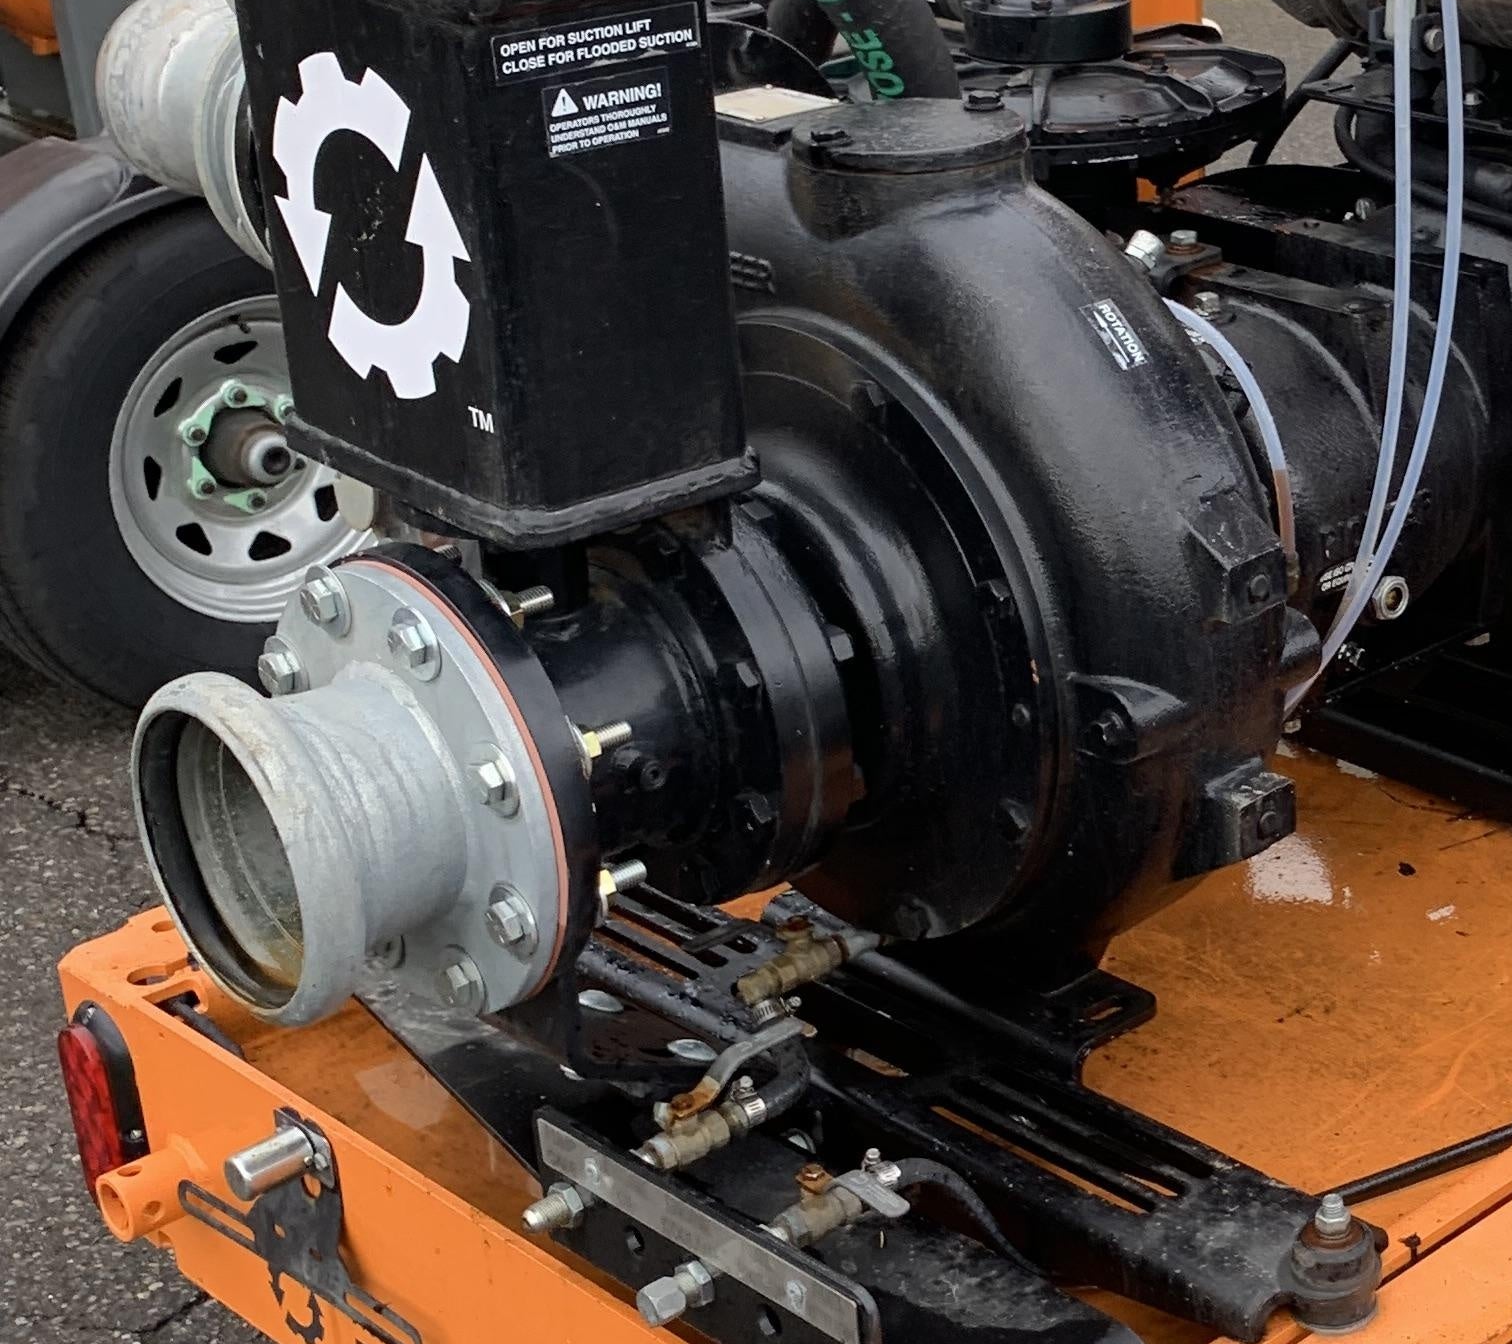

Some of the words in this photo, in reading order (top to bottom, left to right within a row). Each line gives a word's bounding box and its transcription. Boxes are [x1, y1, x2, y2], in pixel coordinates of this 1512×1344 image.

[500, 41, 537, 58] OPEN
[538, 35, 566, 51] FOR
[566, 23, 624, 45] SUCTION
[625, 18, 652, 35] LIFT
[502, 54, 546, 75] CLOSE
[548, 49, 575, 67] FOR
[576, 40, 637, 62] FLOODED
[638, 29, 693, 49] SUCTION
[841, 27, 905, 102] OSE
[582, 82, 662, 111] WARNING!
[549, 115, 600, 133] OPERATORS
[600, 104, 657, 123] THOROUGHLY
[550, 125, 606, 144] UNDERSTAND
[607, 119, 627, 133] O&M
[627, 112, 668, 129] MANUALS
[551, 141, 579, 155] PRIOR
[579, 137, 591, 149] TO
[592, 129, 640, 147] OPERATION
[1098, 303, 1146, 363] ROTATION
[468, 405, 494, 434] TM
